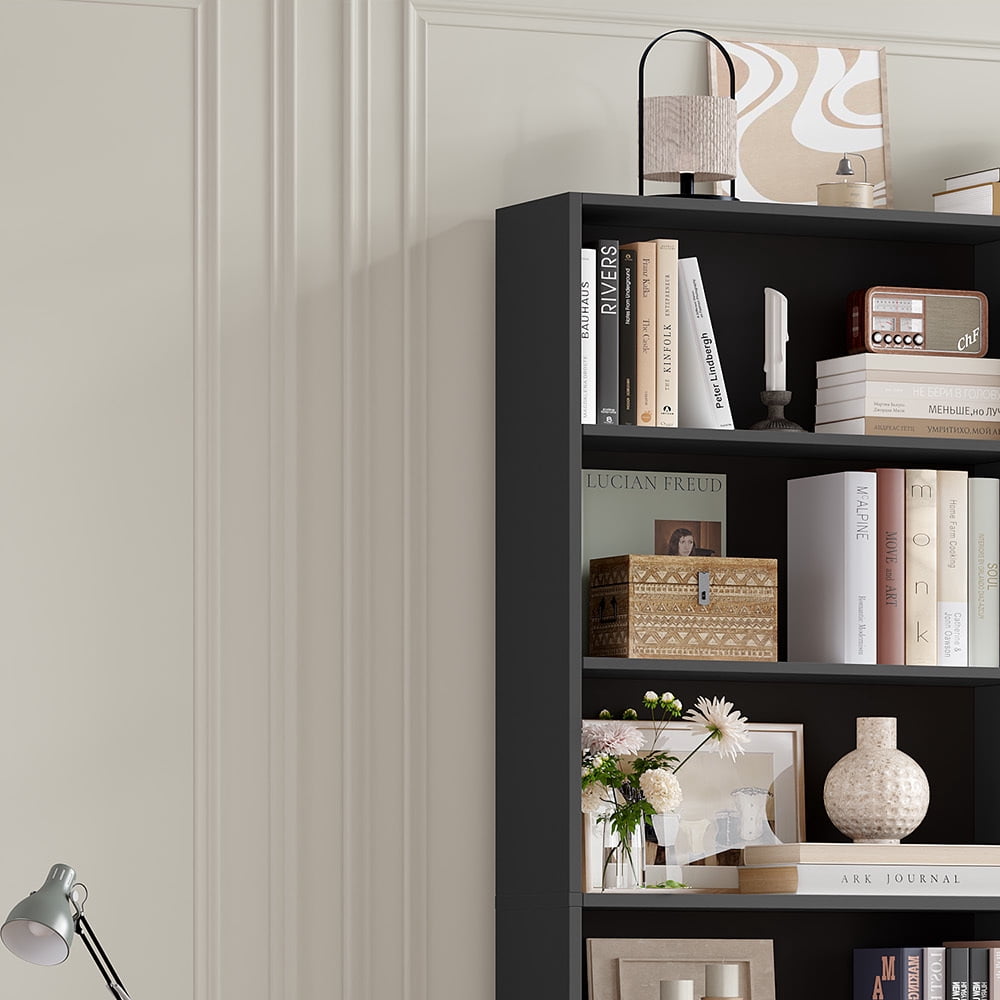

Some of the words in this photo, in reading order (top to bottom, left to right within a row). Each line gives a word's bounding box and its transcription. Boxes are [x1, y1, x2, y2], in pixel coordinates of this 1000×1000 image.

[600, 246, 617, 315] RIVERS
[581, 281, 590, 339] BAUHAUS
[663, 324, 672, 373] KINFOLK
[701, 332, 717, 381] Lindbergh
[713, 384, 724, 409] Peter
[587, 474, 657, 490] LUCIAN
[664, 476, 722, 493] FREUD
[949, 499, 957, 519] Home
[949, 522, 957, 538] Farm
[885, 531, 897, 564] MOVE
[947, 540, 957, 568] Cooking
[885, 568, 894, 581] and
[987, 563, 997, 590] SOUL
[885, 584, 897, 607] ART
[841, 874, 872, 884] ARK
[886, 873, 960, 885] JOURNAL
